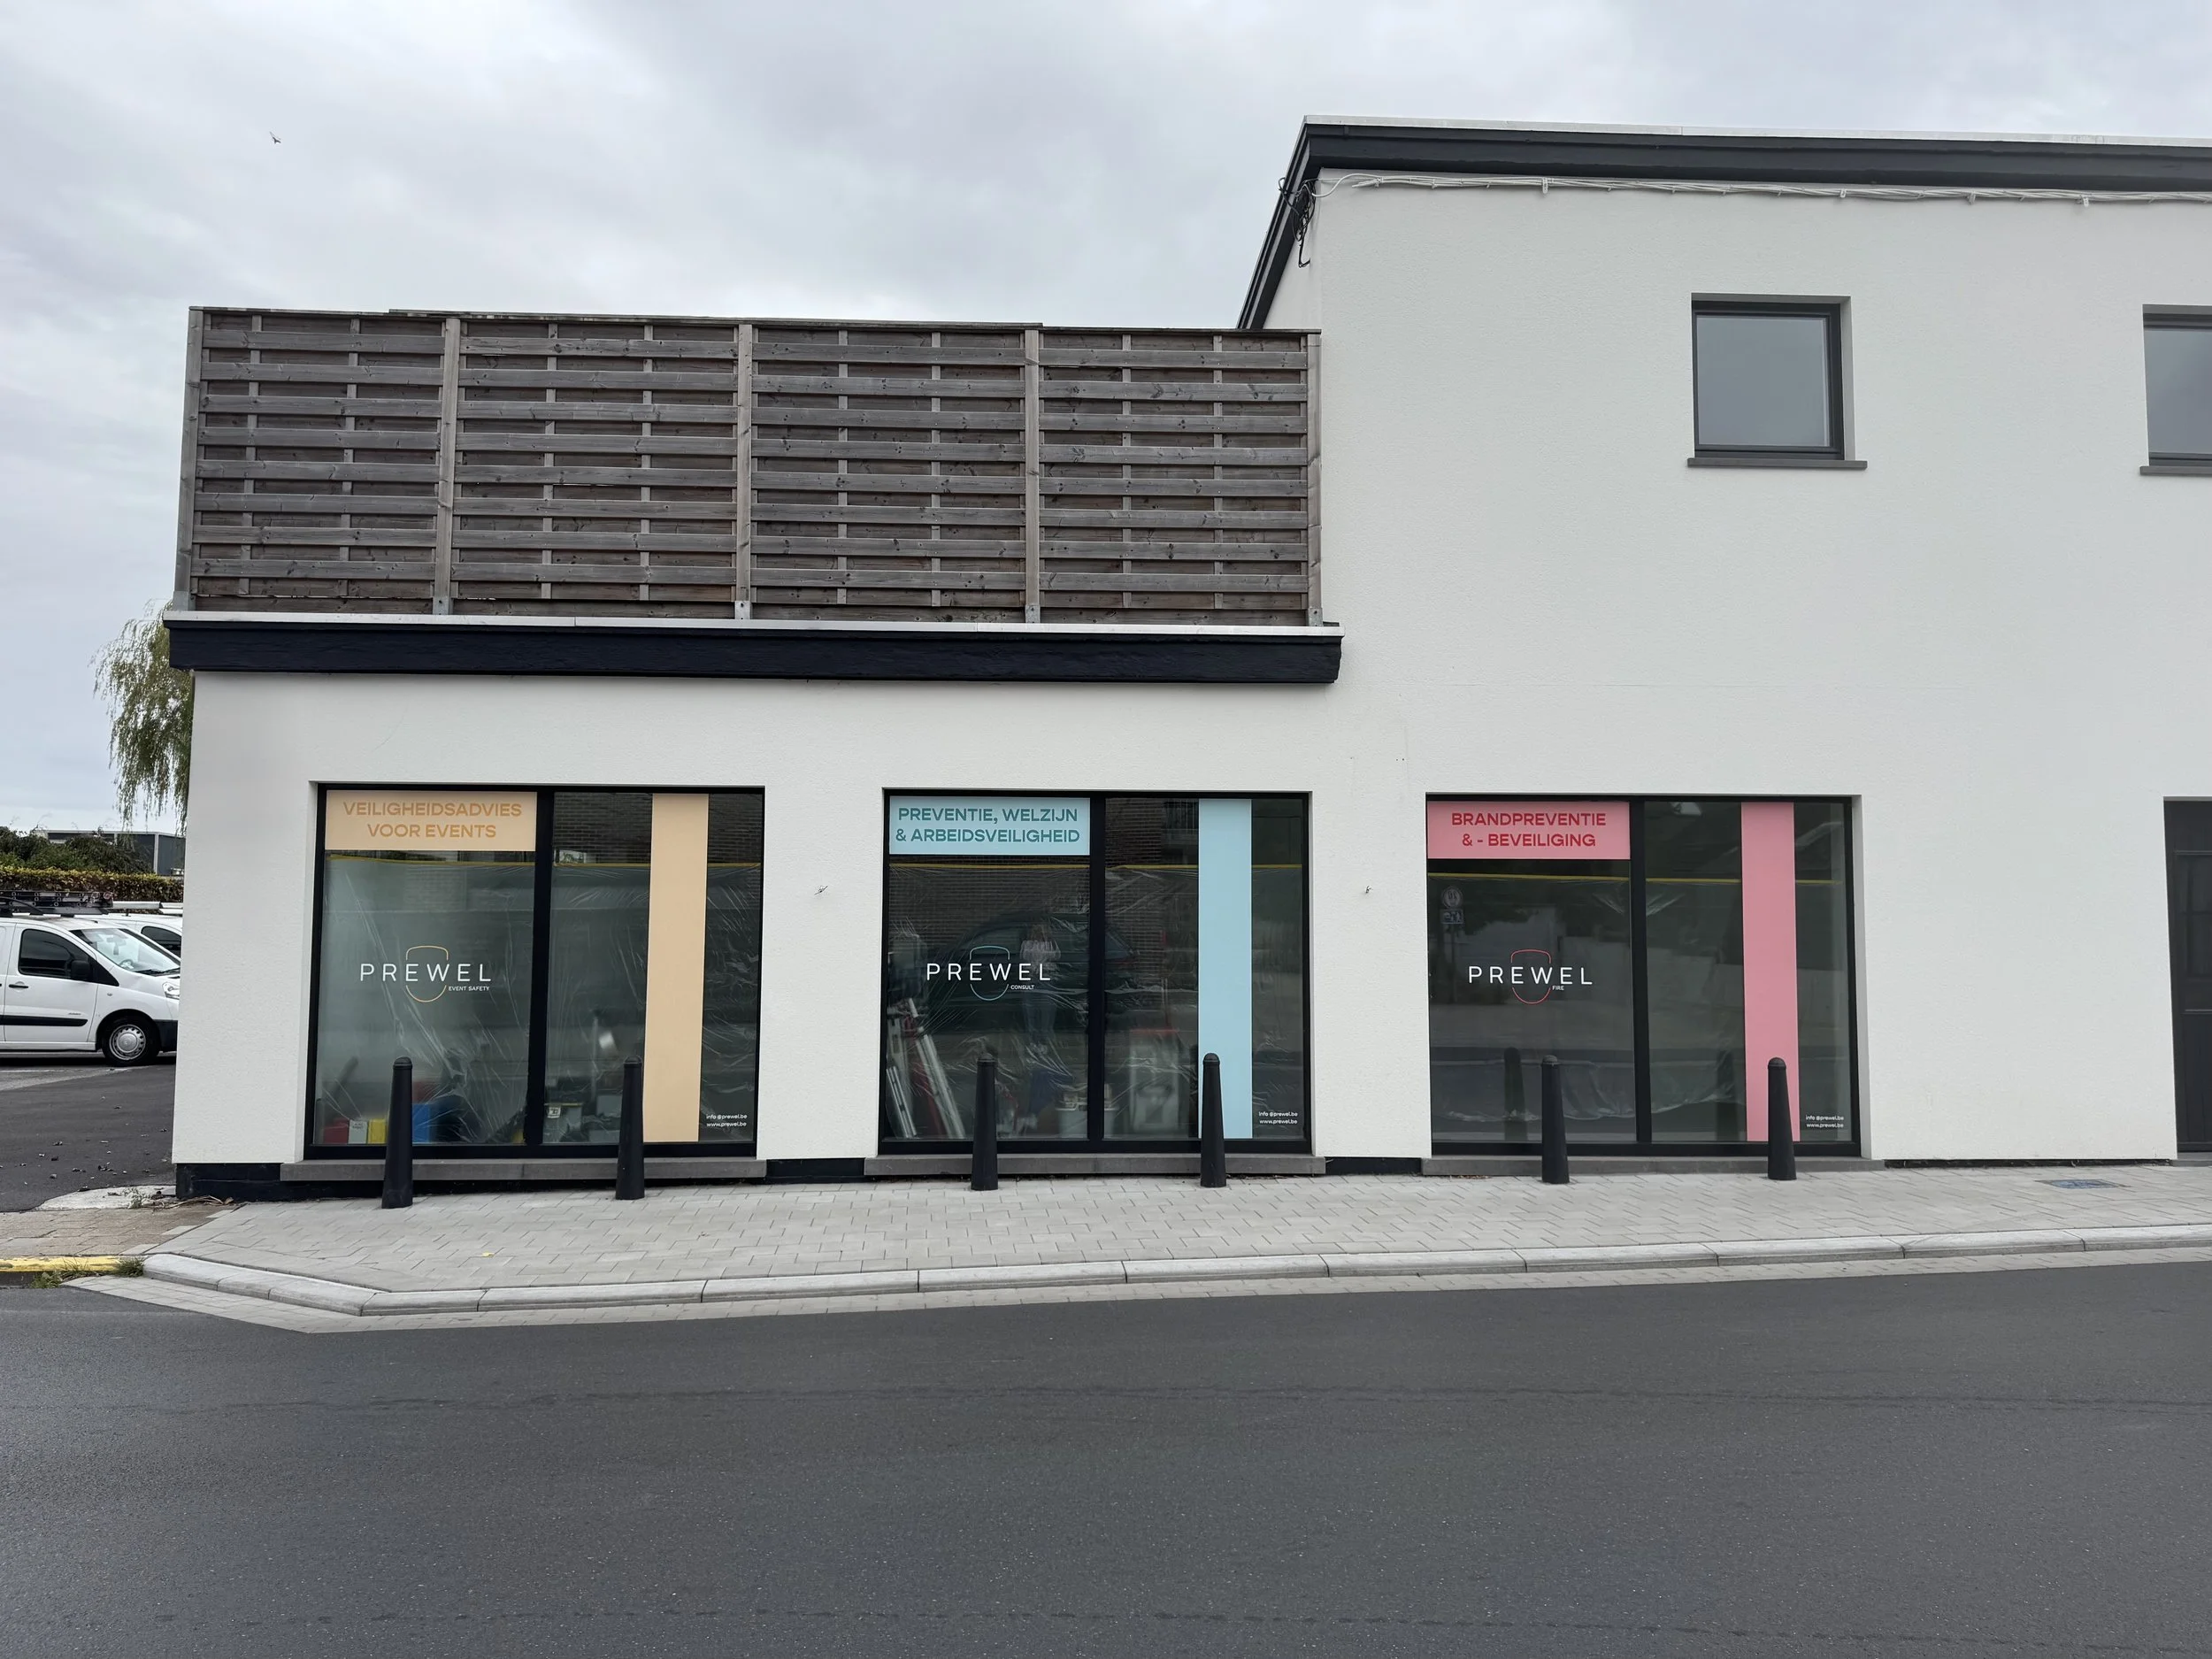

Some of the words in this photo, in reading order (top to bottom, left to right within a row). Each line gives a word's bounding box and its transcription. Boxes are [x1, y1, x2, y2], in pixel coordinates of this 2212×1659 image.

[342, 801, 522, 817] VEILIGHEIDSADVIES
[898, 807, 998, 824] PREVENTIE,
[1002, 808, 1078, 822] WELZIJN
[1451, 812, 1606, 826] BRANDPREVENTIE
[367, 823, 420, 838] VOOR
[425, 824, 496, 838] EVENTS
[895, 828, 907, 841] &
[910, 828, 1080, 842] ARBEIDSVEILIGHEID
[1462, 833, 1473, 847] &
[1487, 833, 1596, 847] BEVEILIGING
[360, 964, 491, 982] PREWEL
[926, 963, 1051, 981] PREWEL
[1468, 965, 1593, 985] PREWEL
